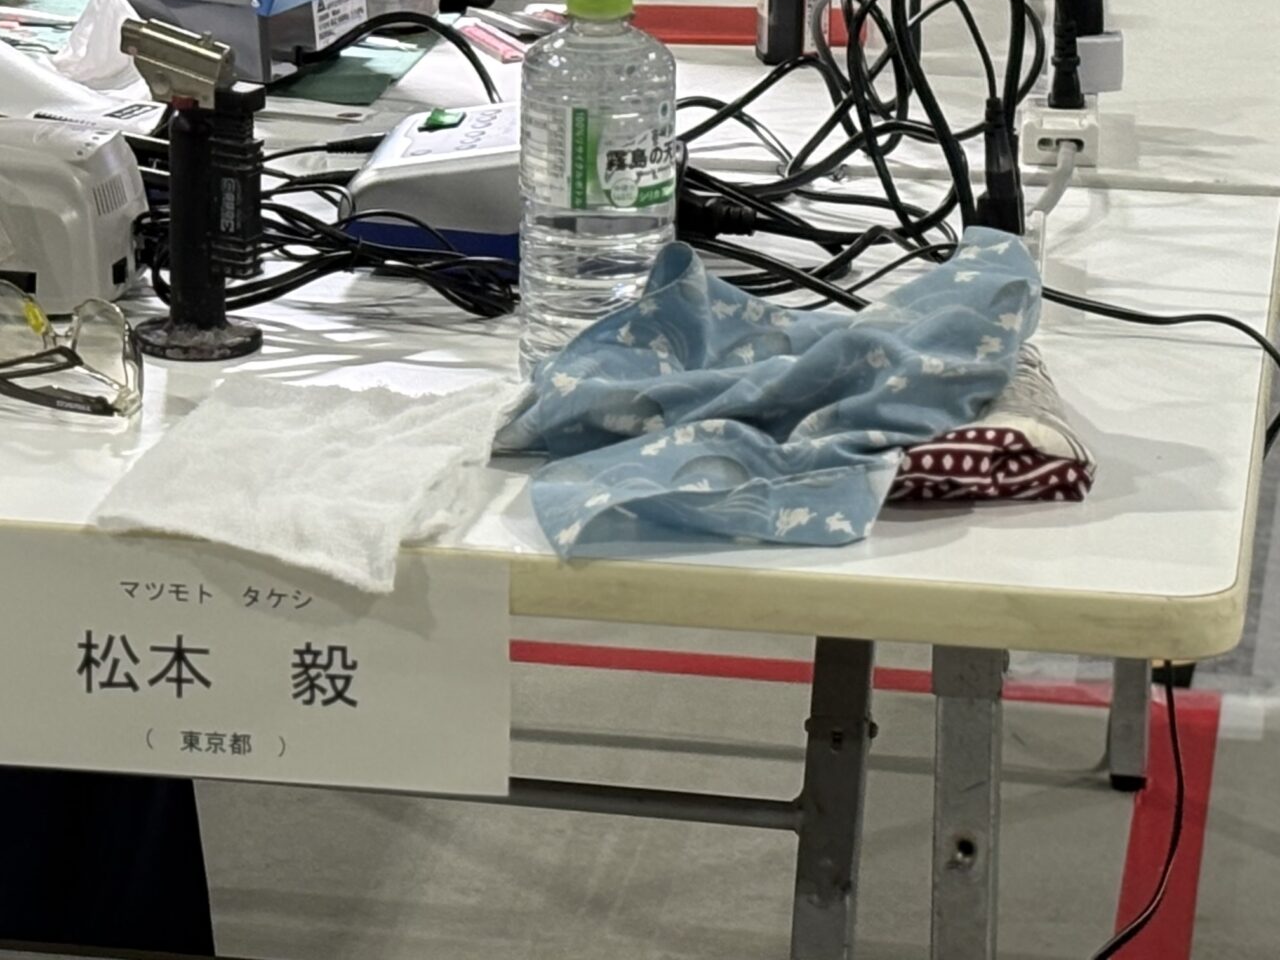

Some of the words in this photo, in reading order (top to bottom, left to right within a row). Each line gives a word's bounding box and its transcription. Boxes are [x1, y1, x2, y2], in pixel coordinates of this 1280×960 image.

[120, 581, 213, 605] マツモト
[243, 585, 313, 609] タケシ
[76, 629, 212, 699] 松本
[291, 641, 358, 708] 毅
[180, 730, 252, 755] 東京都
